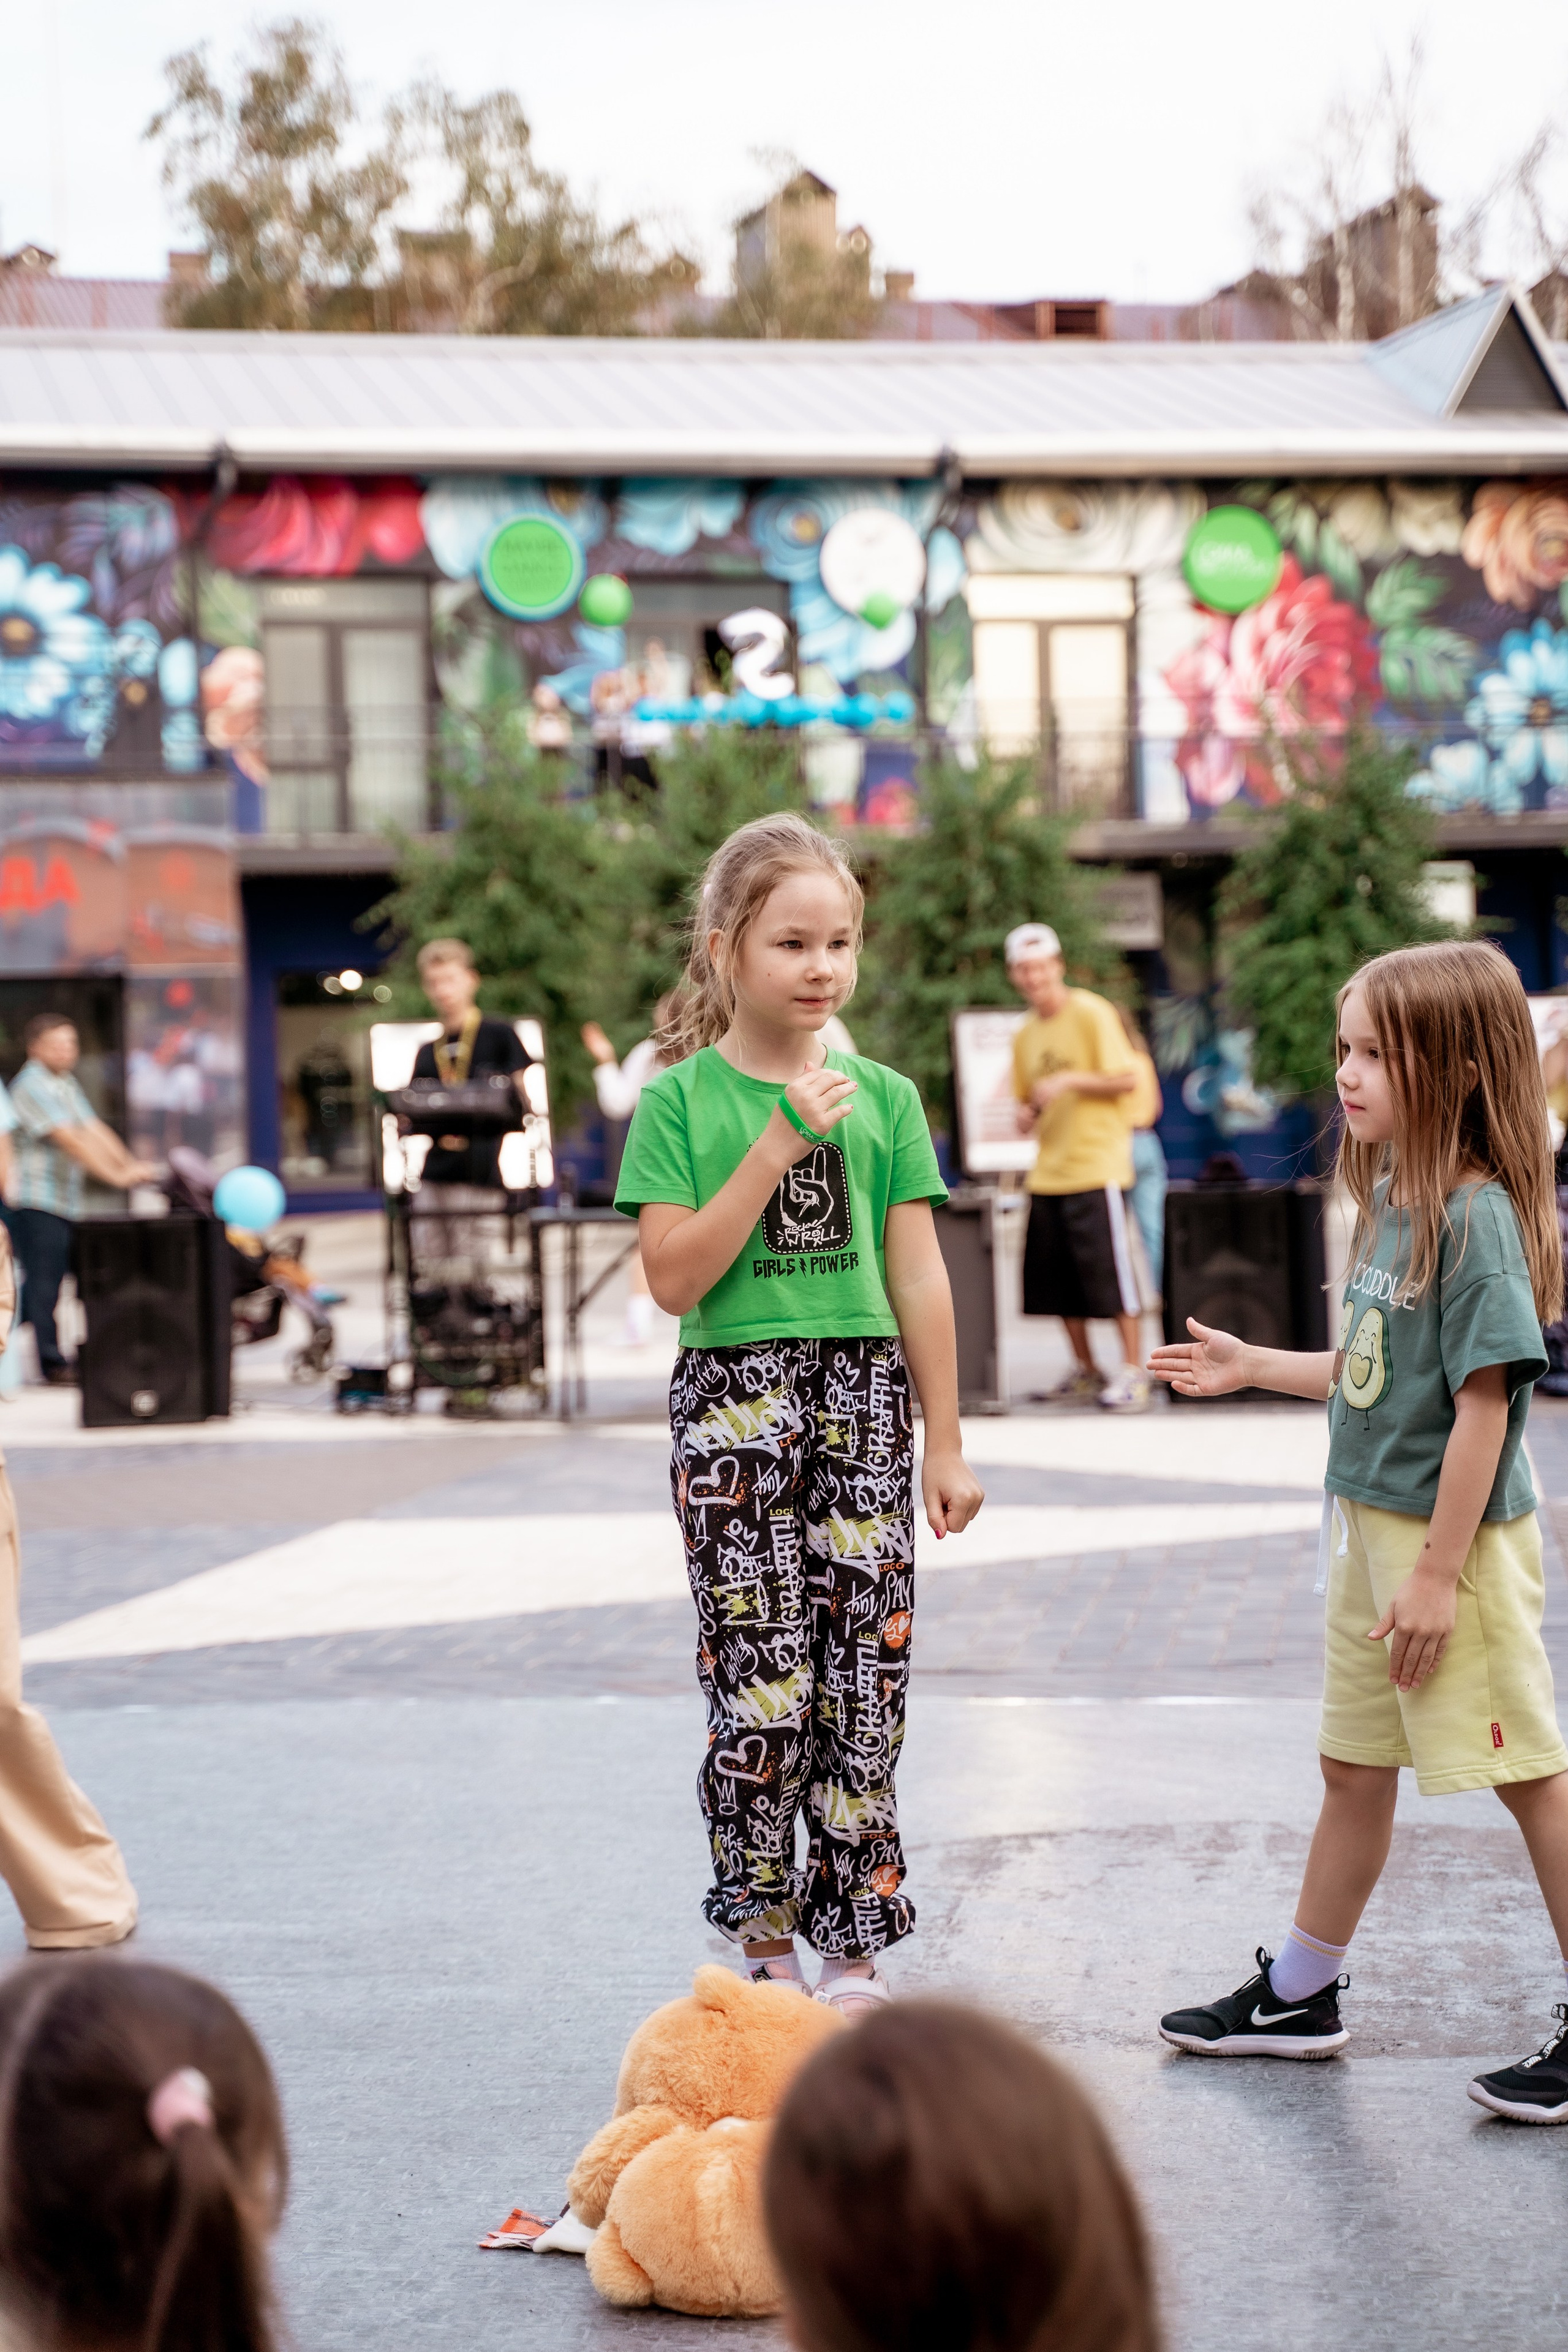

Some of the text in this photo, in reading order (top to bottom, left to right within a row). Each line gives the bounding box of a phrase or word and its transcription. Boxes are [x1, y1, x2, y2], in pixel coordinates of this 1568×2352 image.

[785, 1223, 810, 1242] ROCK
[802, 1226, 841, 1248] ROLL
[753, 1252, 859, 1279] GIRLS POWER
[879, 1562, 905, 1572] LOCO
[880, 1570, 914, 1618] SAY
[784, 1776, 801, 1787] LOCO
[860, 1839, 905, 1872] SAY
